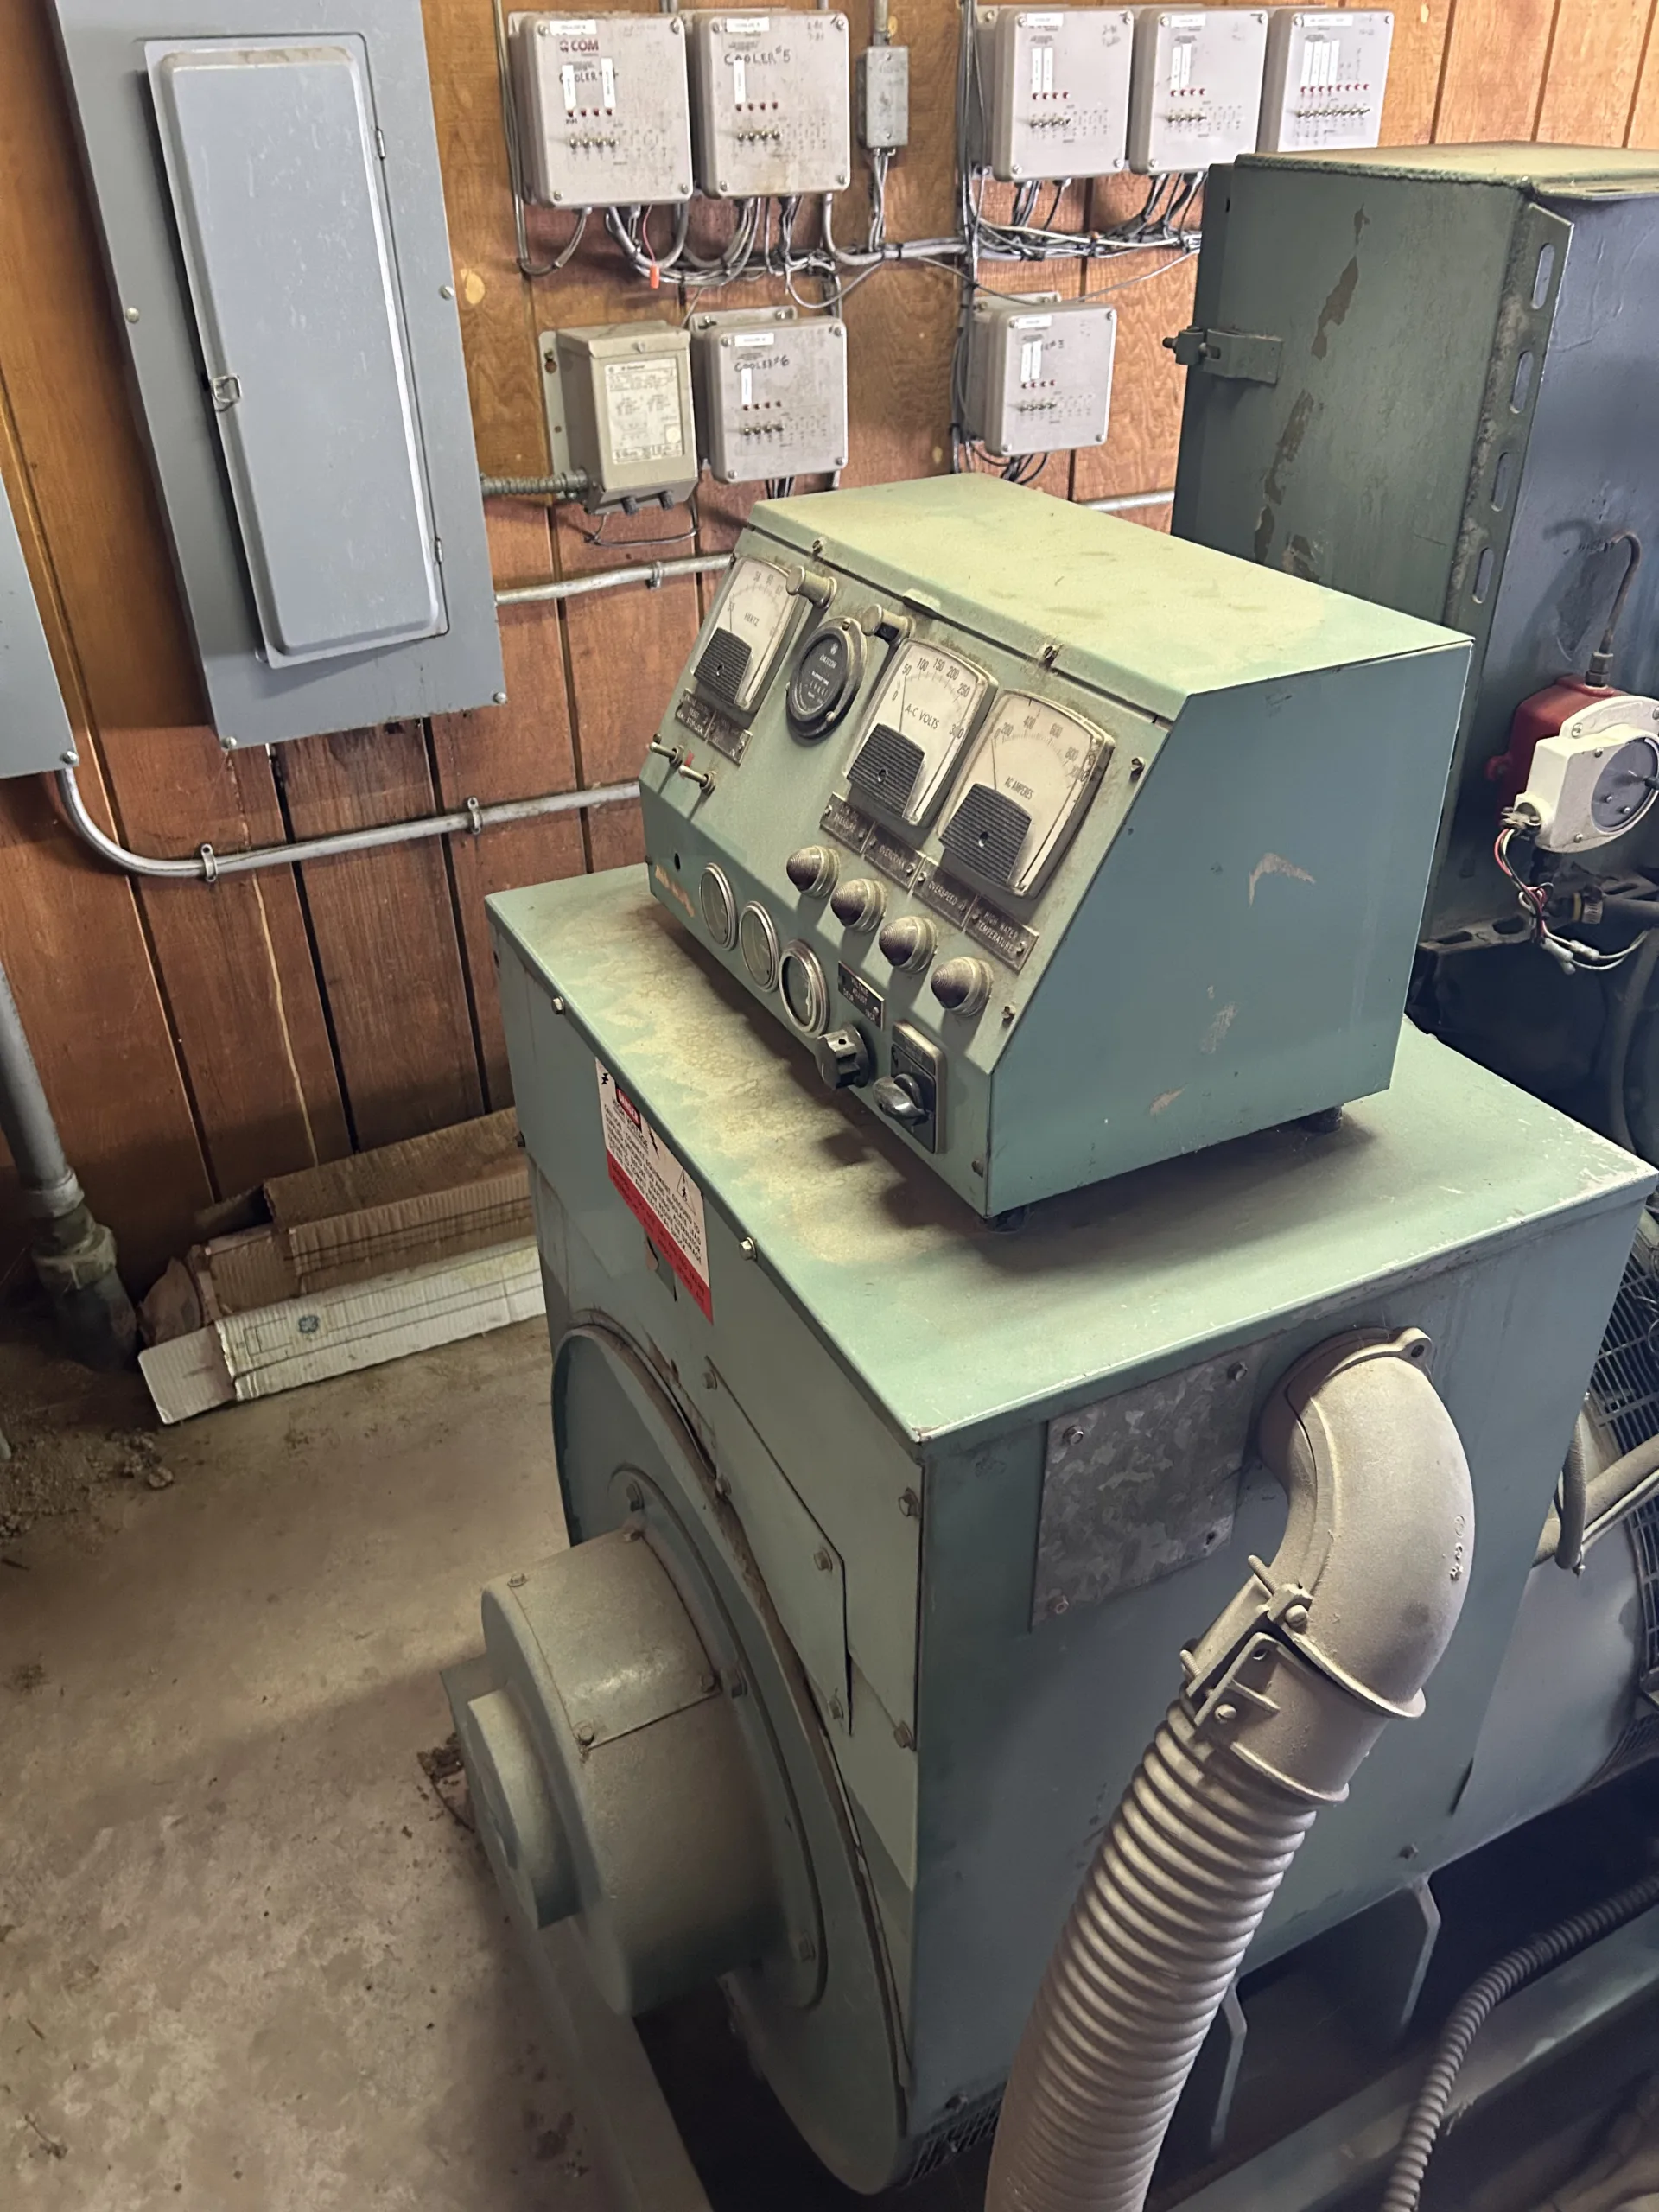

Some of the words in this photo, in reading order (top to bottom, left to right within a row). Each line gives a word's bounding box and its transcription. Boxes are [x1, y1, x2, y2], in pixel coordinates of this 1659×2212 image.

[744, 612, 760, 627] HERTZ
[902, 663, 912, 675] 50
[917, 658, 929, 671] 100
[933, 658, 945, 671] 150
[946, 665, 960, 680] 200
[892, 690, 898, 701] 0
[957, 683, 970, 697] 250
[905, 703, 918, 717] A-C
[919, 710, 939, 729] VOLTS
[949, 723, 964, 739] 30
[1011, 780, 1034, 800] AMPERES
[928, 880, 958, 906] OVERSPEED
[984, 911, 999, 925] HIGH
[1000, 921, 1018, 941] WATER
[976, 918, 1014, 951] TEMPERATURE
